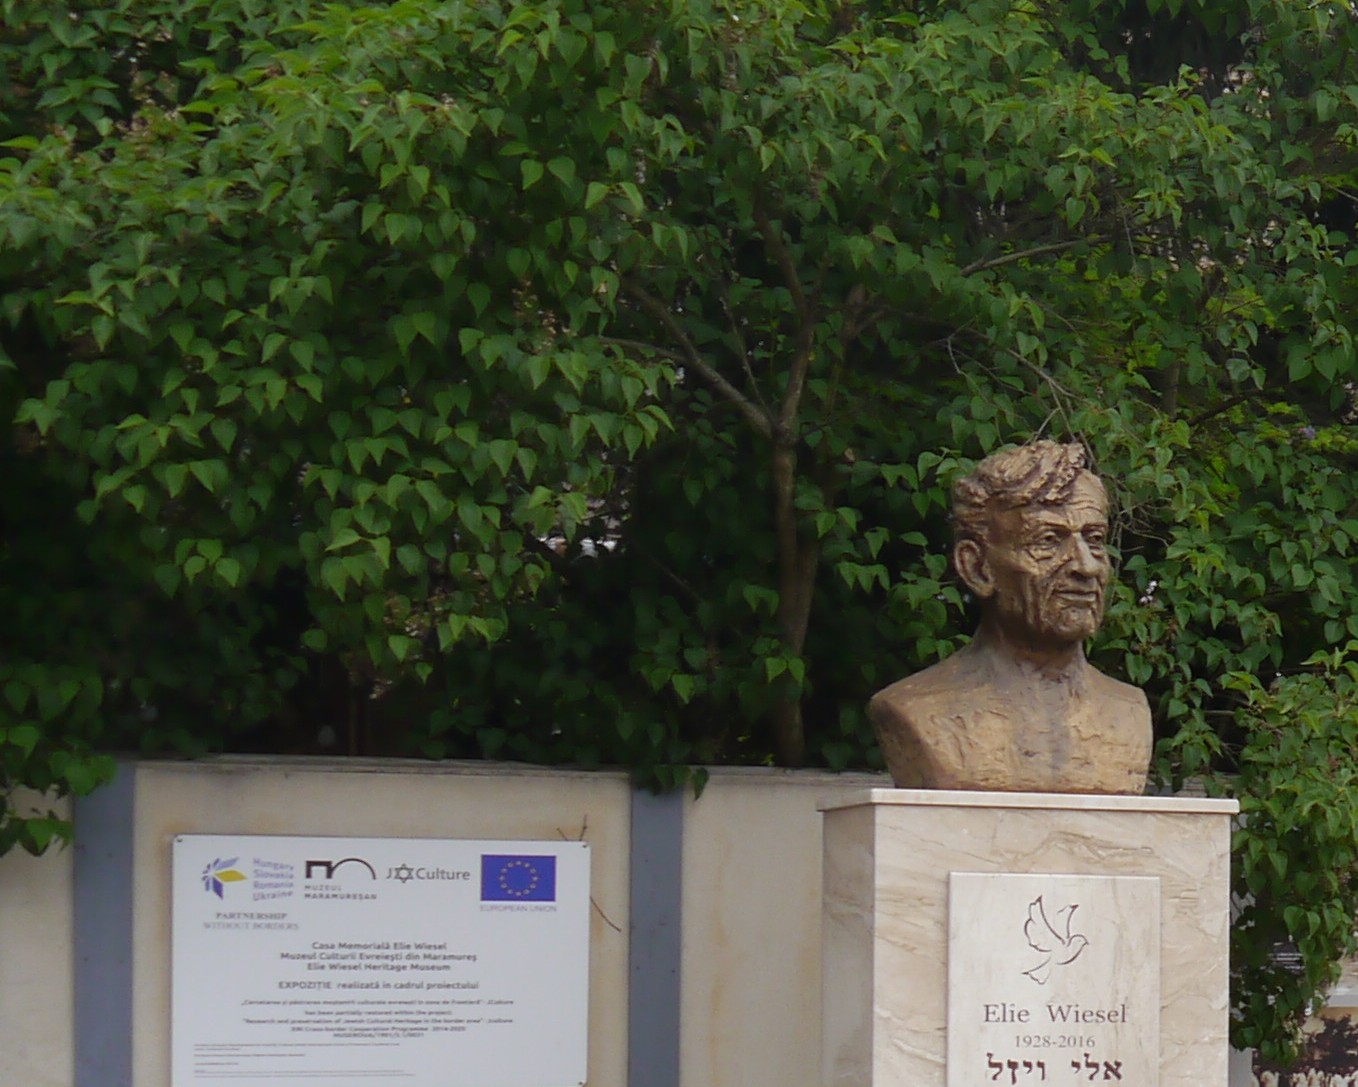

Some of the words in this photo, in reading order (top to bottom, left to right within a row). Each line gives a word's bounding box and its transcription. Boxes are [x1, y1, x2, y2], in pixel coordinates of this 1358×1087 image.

[984, 1003, 1030, 1023] Elie
[1047, 1003, 1128, 1024] Wiesel
[1015, 1035, 1096, 1048] 1928-2016
[986, 1052, 1046, 1086] ויזל
[1071, 1053, 1123, 1081] אלי
